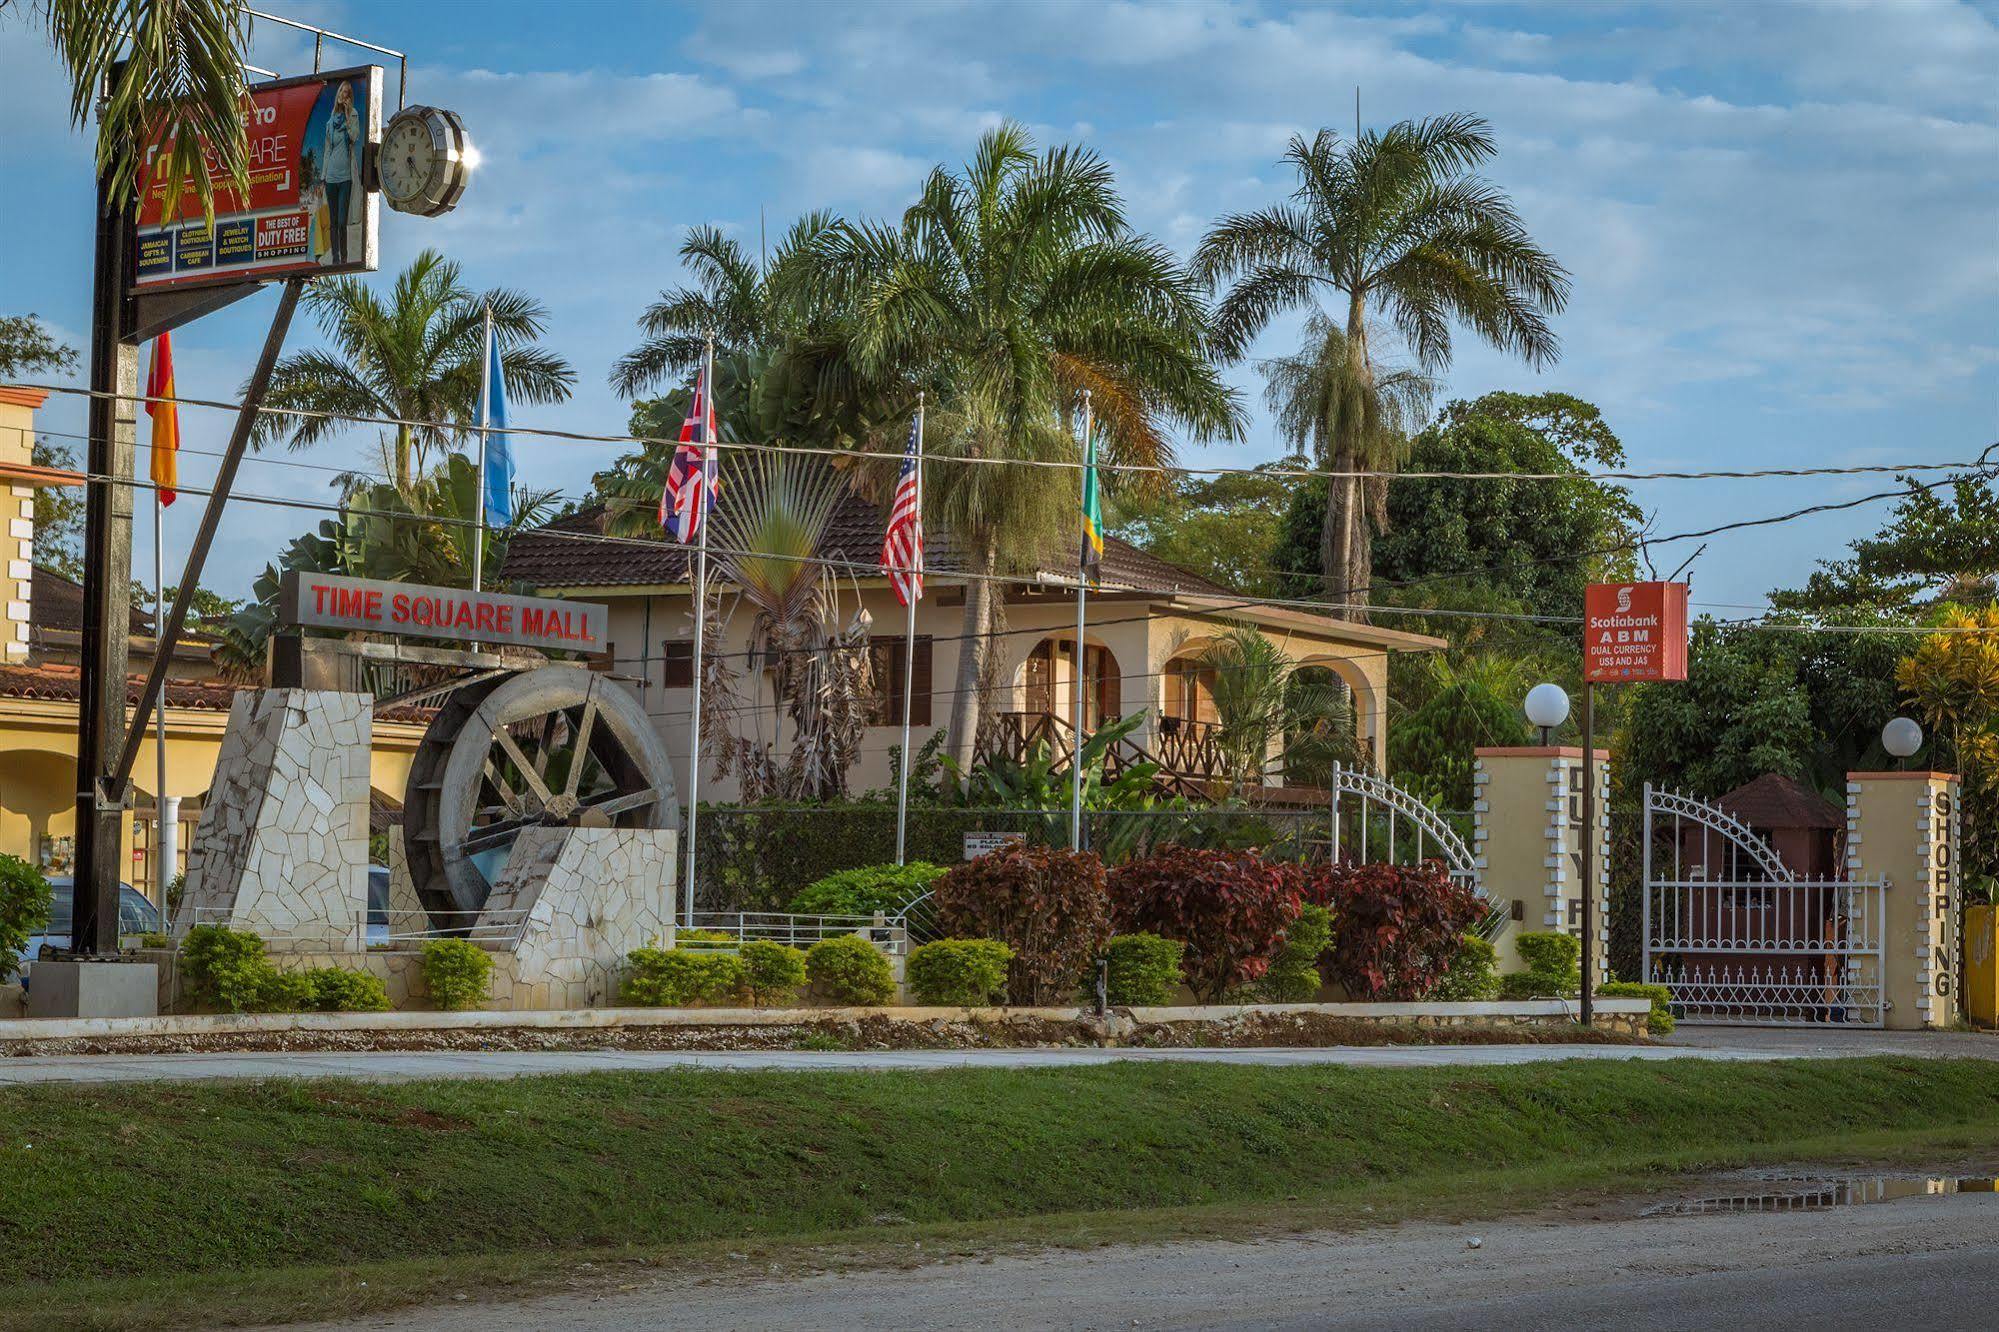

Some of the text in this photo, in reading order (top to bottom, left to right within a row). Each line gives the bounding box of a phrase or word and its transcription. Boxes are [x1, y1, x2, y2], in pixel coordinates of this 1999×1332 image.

[266, 216, 300, 230] THE BEST OF
[223, 227, 249, 237] JEWELRY
[258, 226, 306, 247] DUTY FREE
[141, 239, 169, 250] JAMAICAN
[228, 236, 249, 245] WATCH
[143, 250, 160, 258] GIFTS
[180, 250, 209, 260] CARIBBEAN
[219, 244, 253, 255] BOUTIQUES
[257, 246, 306, 258] SHOPPING
[139, 256, 170, 267] SOUVENIRS
[311, 584, 597, 641] TIME SQUARE MALL
[1590, 614, 1658, 629] Scotiabank
[1591, 644, 1657, 655] DUAL CURRENCY
[1600, 655, 1648, 666] US$ AND JA$
[1935, 791, 1951, 997] SHOPPING
